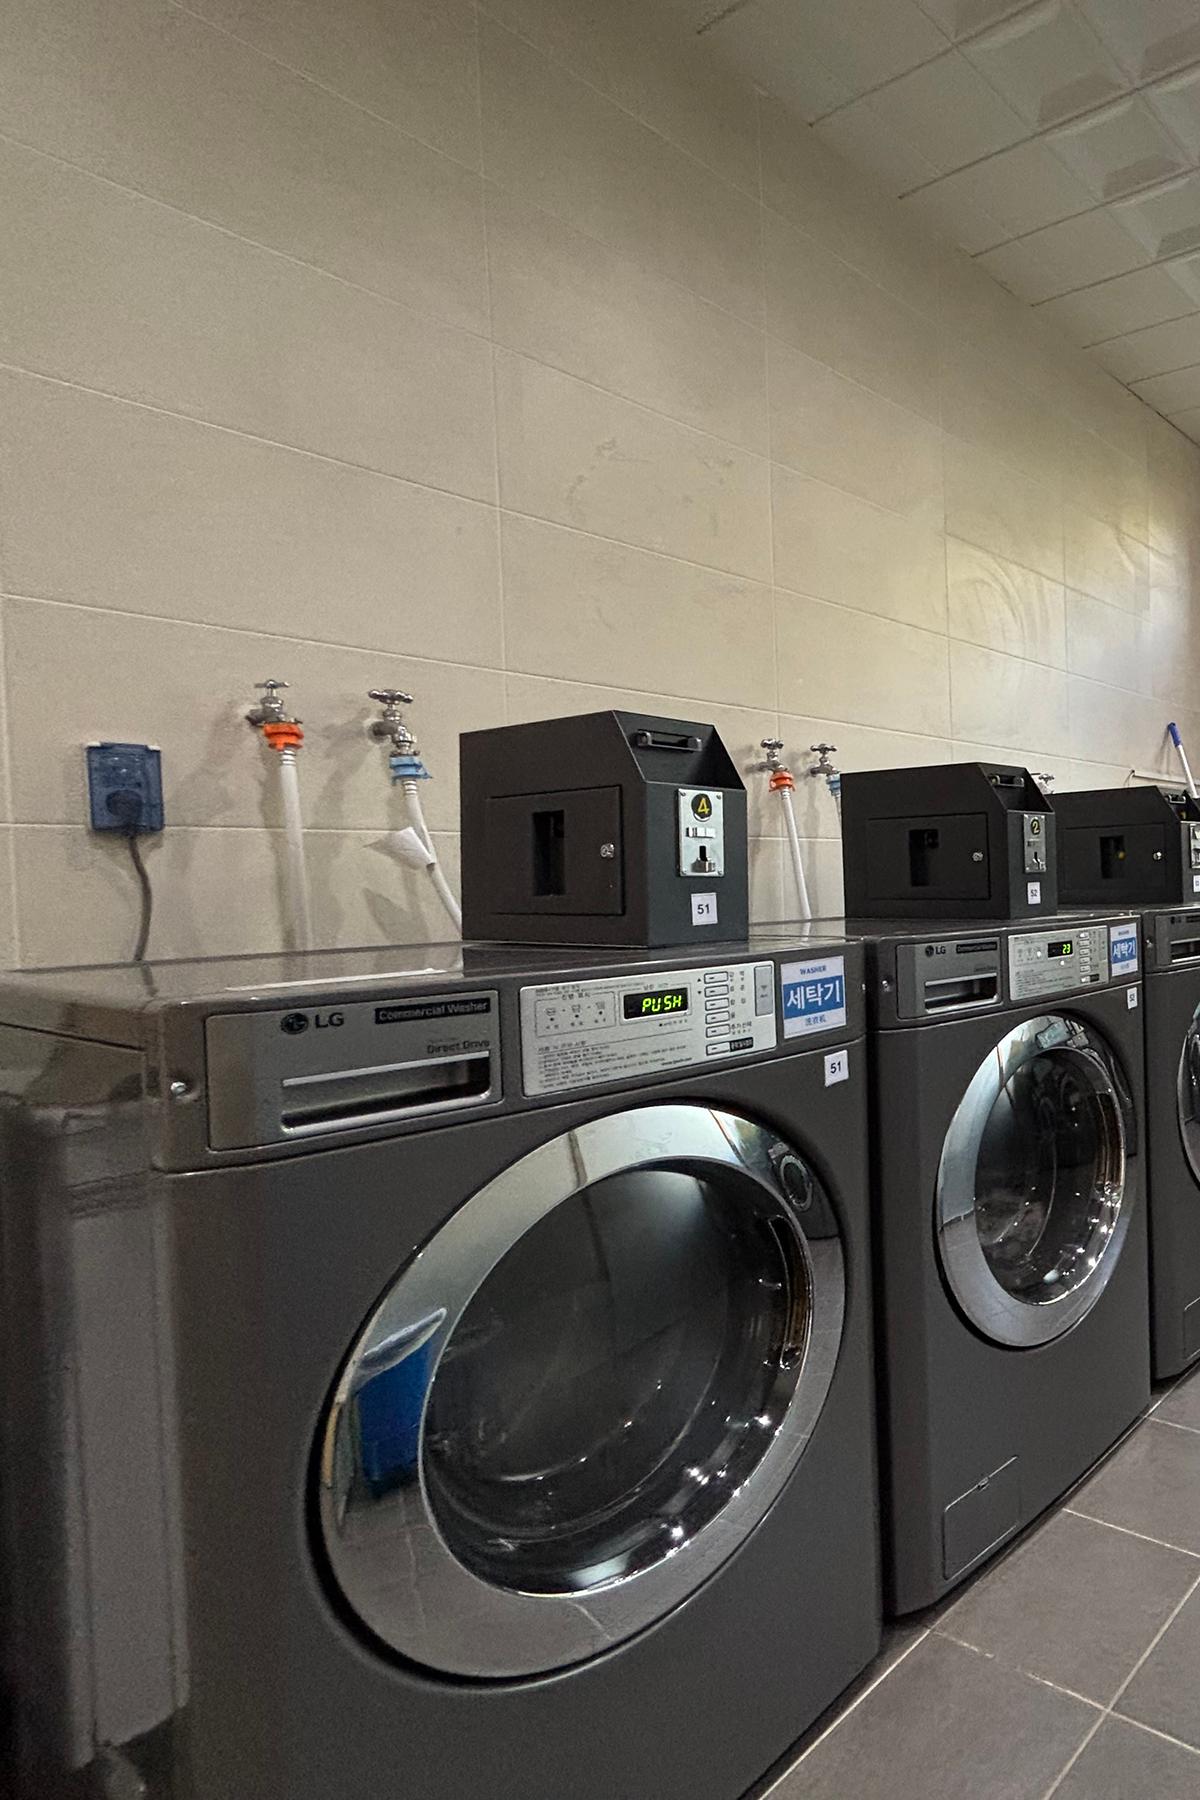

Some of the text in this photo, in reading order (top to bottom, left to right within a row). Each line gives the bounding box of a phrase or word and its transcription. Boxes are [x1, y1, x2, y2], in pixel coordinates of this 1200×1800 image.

[697, 797, 711, 815] 4
[696, 903, 711, 915] 51
[935, 945, 947, 955] LG
[1062, 943, 1071, 955] 23
[1113, 939, 1136, 959] 세탁기
[799, 965, 827, 976] WASHER
[786, 980, 842, 1010] 세탁기
[379, 1001, 488, 1020] Commercial Washer
[641, 994, 682, 1013] PUSH
[314, 1012, 345, 1029] LG
[426, 1042, 460, 1055] Direct
[830, 1060, 842, 1075] 51
